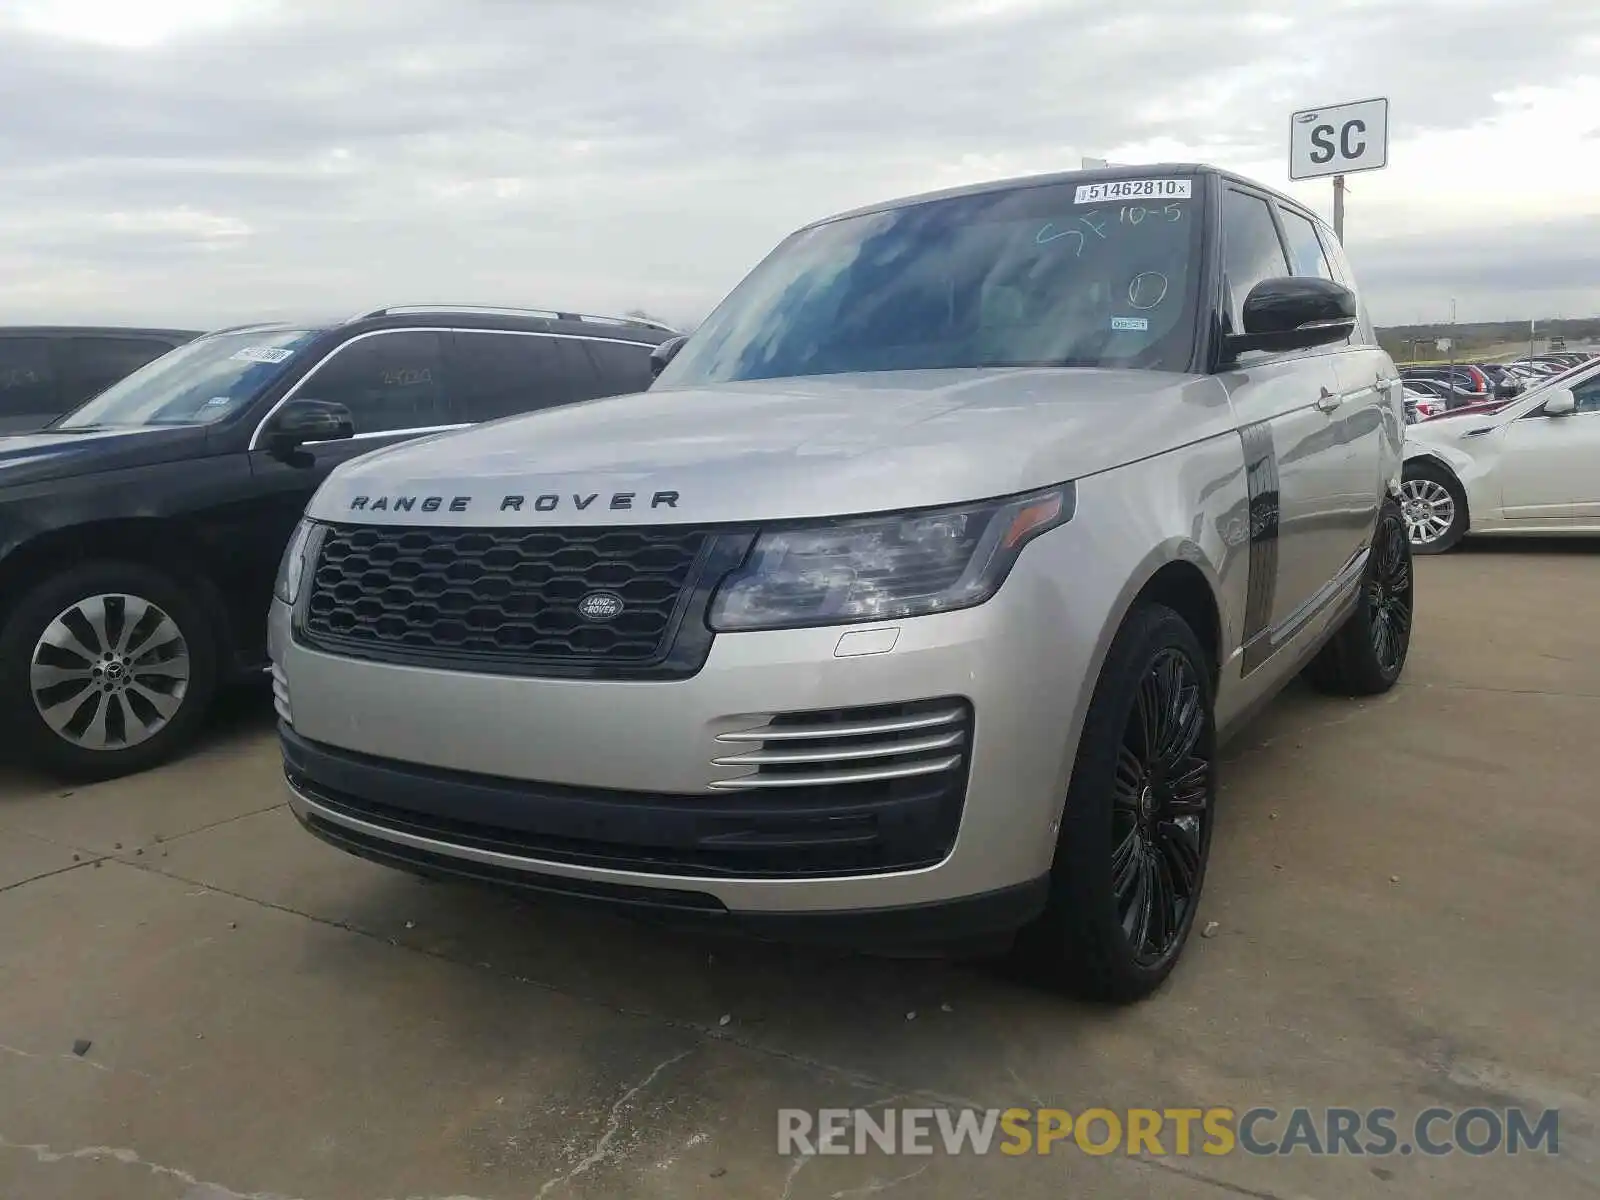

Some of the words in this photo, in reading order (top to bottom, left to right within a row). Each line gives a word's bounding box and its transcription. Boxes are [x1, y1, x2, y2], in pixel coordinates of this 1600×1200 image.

[1309, 119, 1366, 164] SC
[350, 495, 472, 512] RANGE
[499, 490, 681, 512] ROVER
